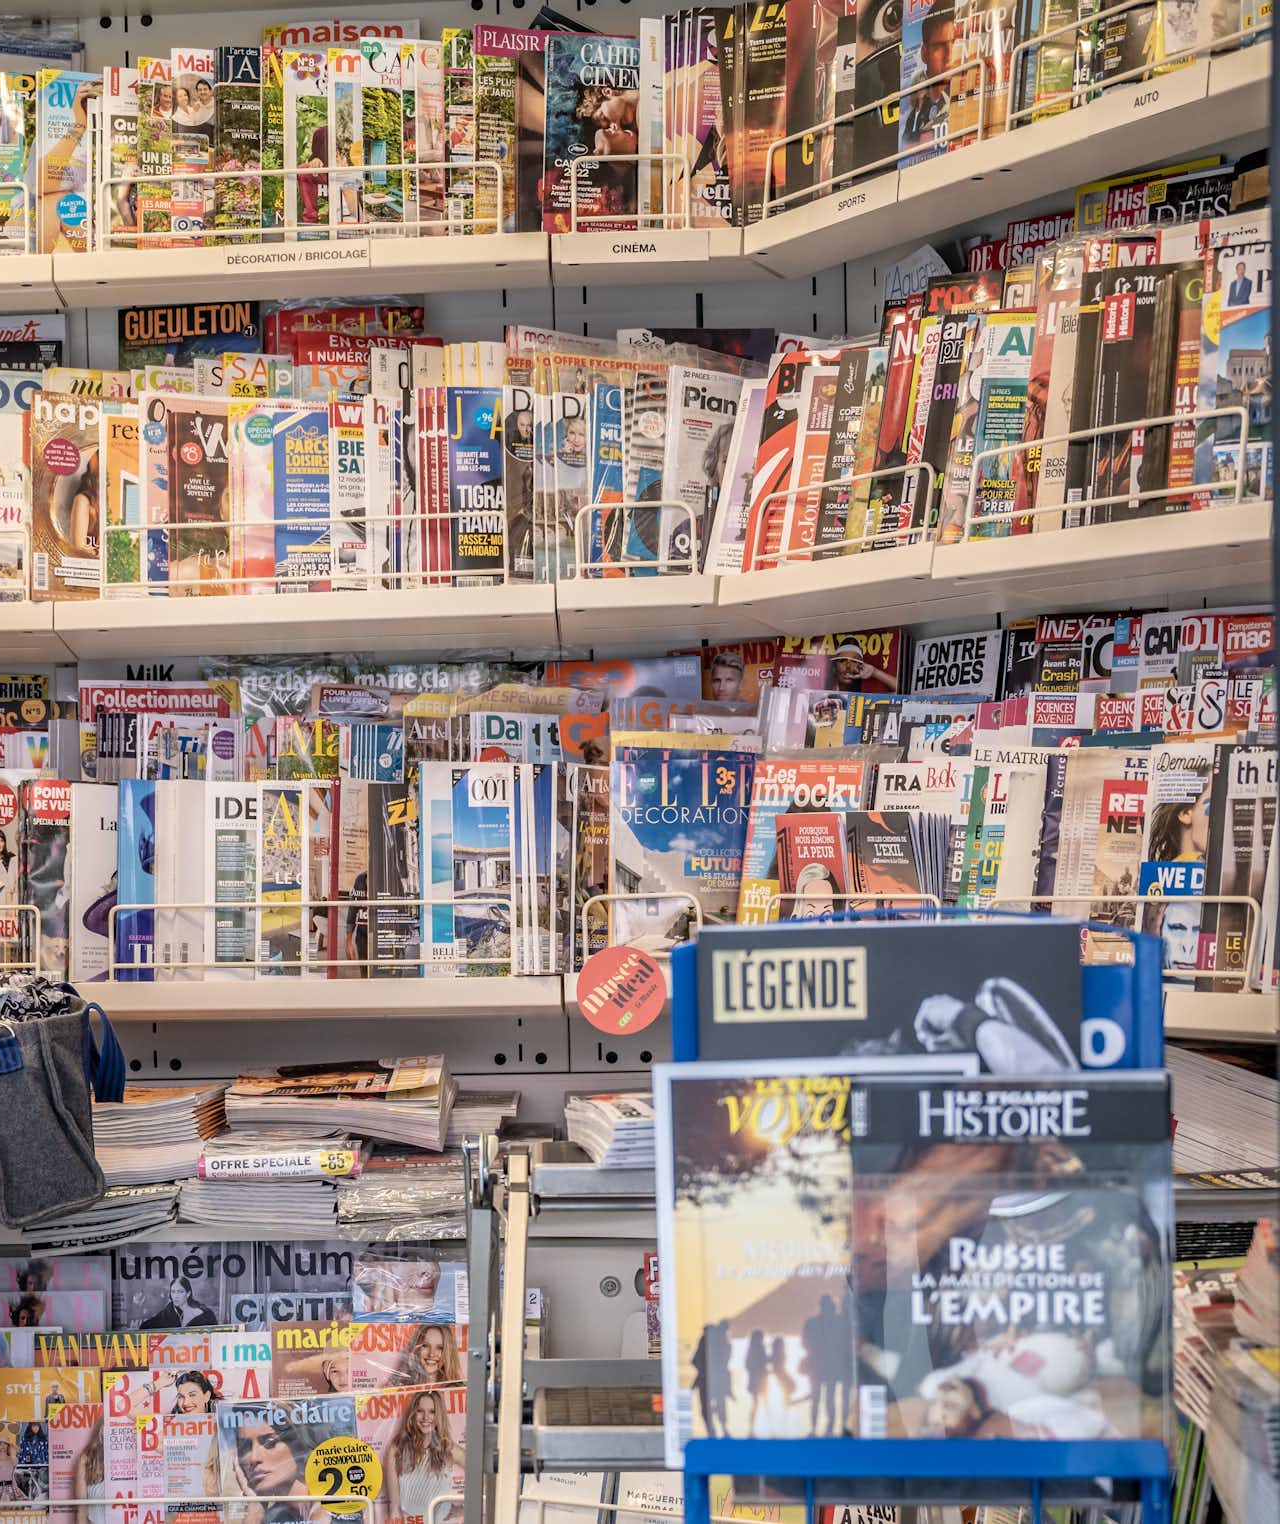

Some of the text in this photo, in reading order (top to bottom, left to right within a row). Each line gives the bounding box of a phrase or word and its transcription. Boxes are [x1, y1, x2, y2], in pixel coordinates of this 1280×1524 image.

[280, 19, 404, 45] maison
[483, 31, 539, 51] PLAISIR
[1134, 90, 1159, 107] AUTO
[142, 151, 159, 164] UN
[564, 168, 589, 178] 222
[837, 194, 866, 212] SPORTS
[612, 242, 657, 254] CINÉMA
[227, 249, 368, 265] DÉCORATION BRICOLAGE
[124, 302, 251, 341] GUEULETON
[329, 334, 351, 348] EN
[235, 383, 250, 393] 56
[189, 478, 200, 486] VIVE
[458, 546, 500, 557] STANDARD
[1226, 630, 1271, 650] mac
[1043, 660, 1067, 668] Avant
[1041, 669, 1079, 682] Crash
[92, 689, 221, 710] Collectionneur
[1036, 702, 1075, 714] SCIENCES
[1125, 757, 1148, 769] LE
[1157, 751, 1209, 771] Demain
[765, 765, 797, 784] Les
[33, 786, 72, 799] POINT
[33, 801, 71, 811] DE VUE
[100, 817, 117, 831] La
[797, 847, 835, 858] LA PEUR
[874, 843, 904, 857] L'EXIL
[1157, 867, 1184, 888] WE
[722, 948, 857, 1012] LÉGENDE
[919, 1089, 1091, 1137] HISTOIRE
[210, 1160, 250, 1171] OFFRE
[911, 1273, 935, 1288] LA
[1080, 1273, 1104, 1288] DE
[911, 1290, 1106, 1325] L'EMPIRE
[6, 1383, 41, 1395] STYLE
[223, 1402, 353, 1429] marie claire
[316, 1443, 368, 1456] marie claire
[323, 1453, 373, 1466] COSMOPOLITAN
[318, 1467, 346, 1505] 2
